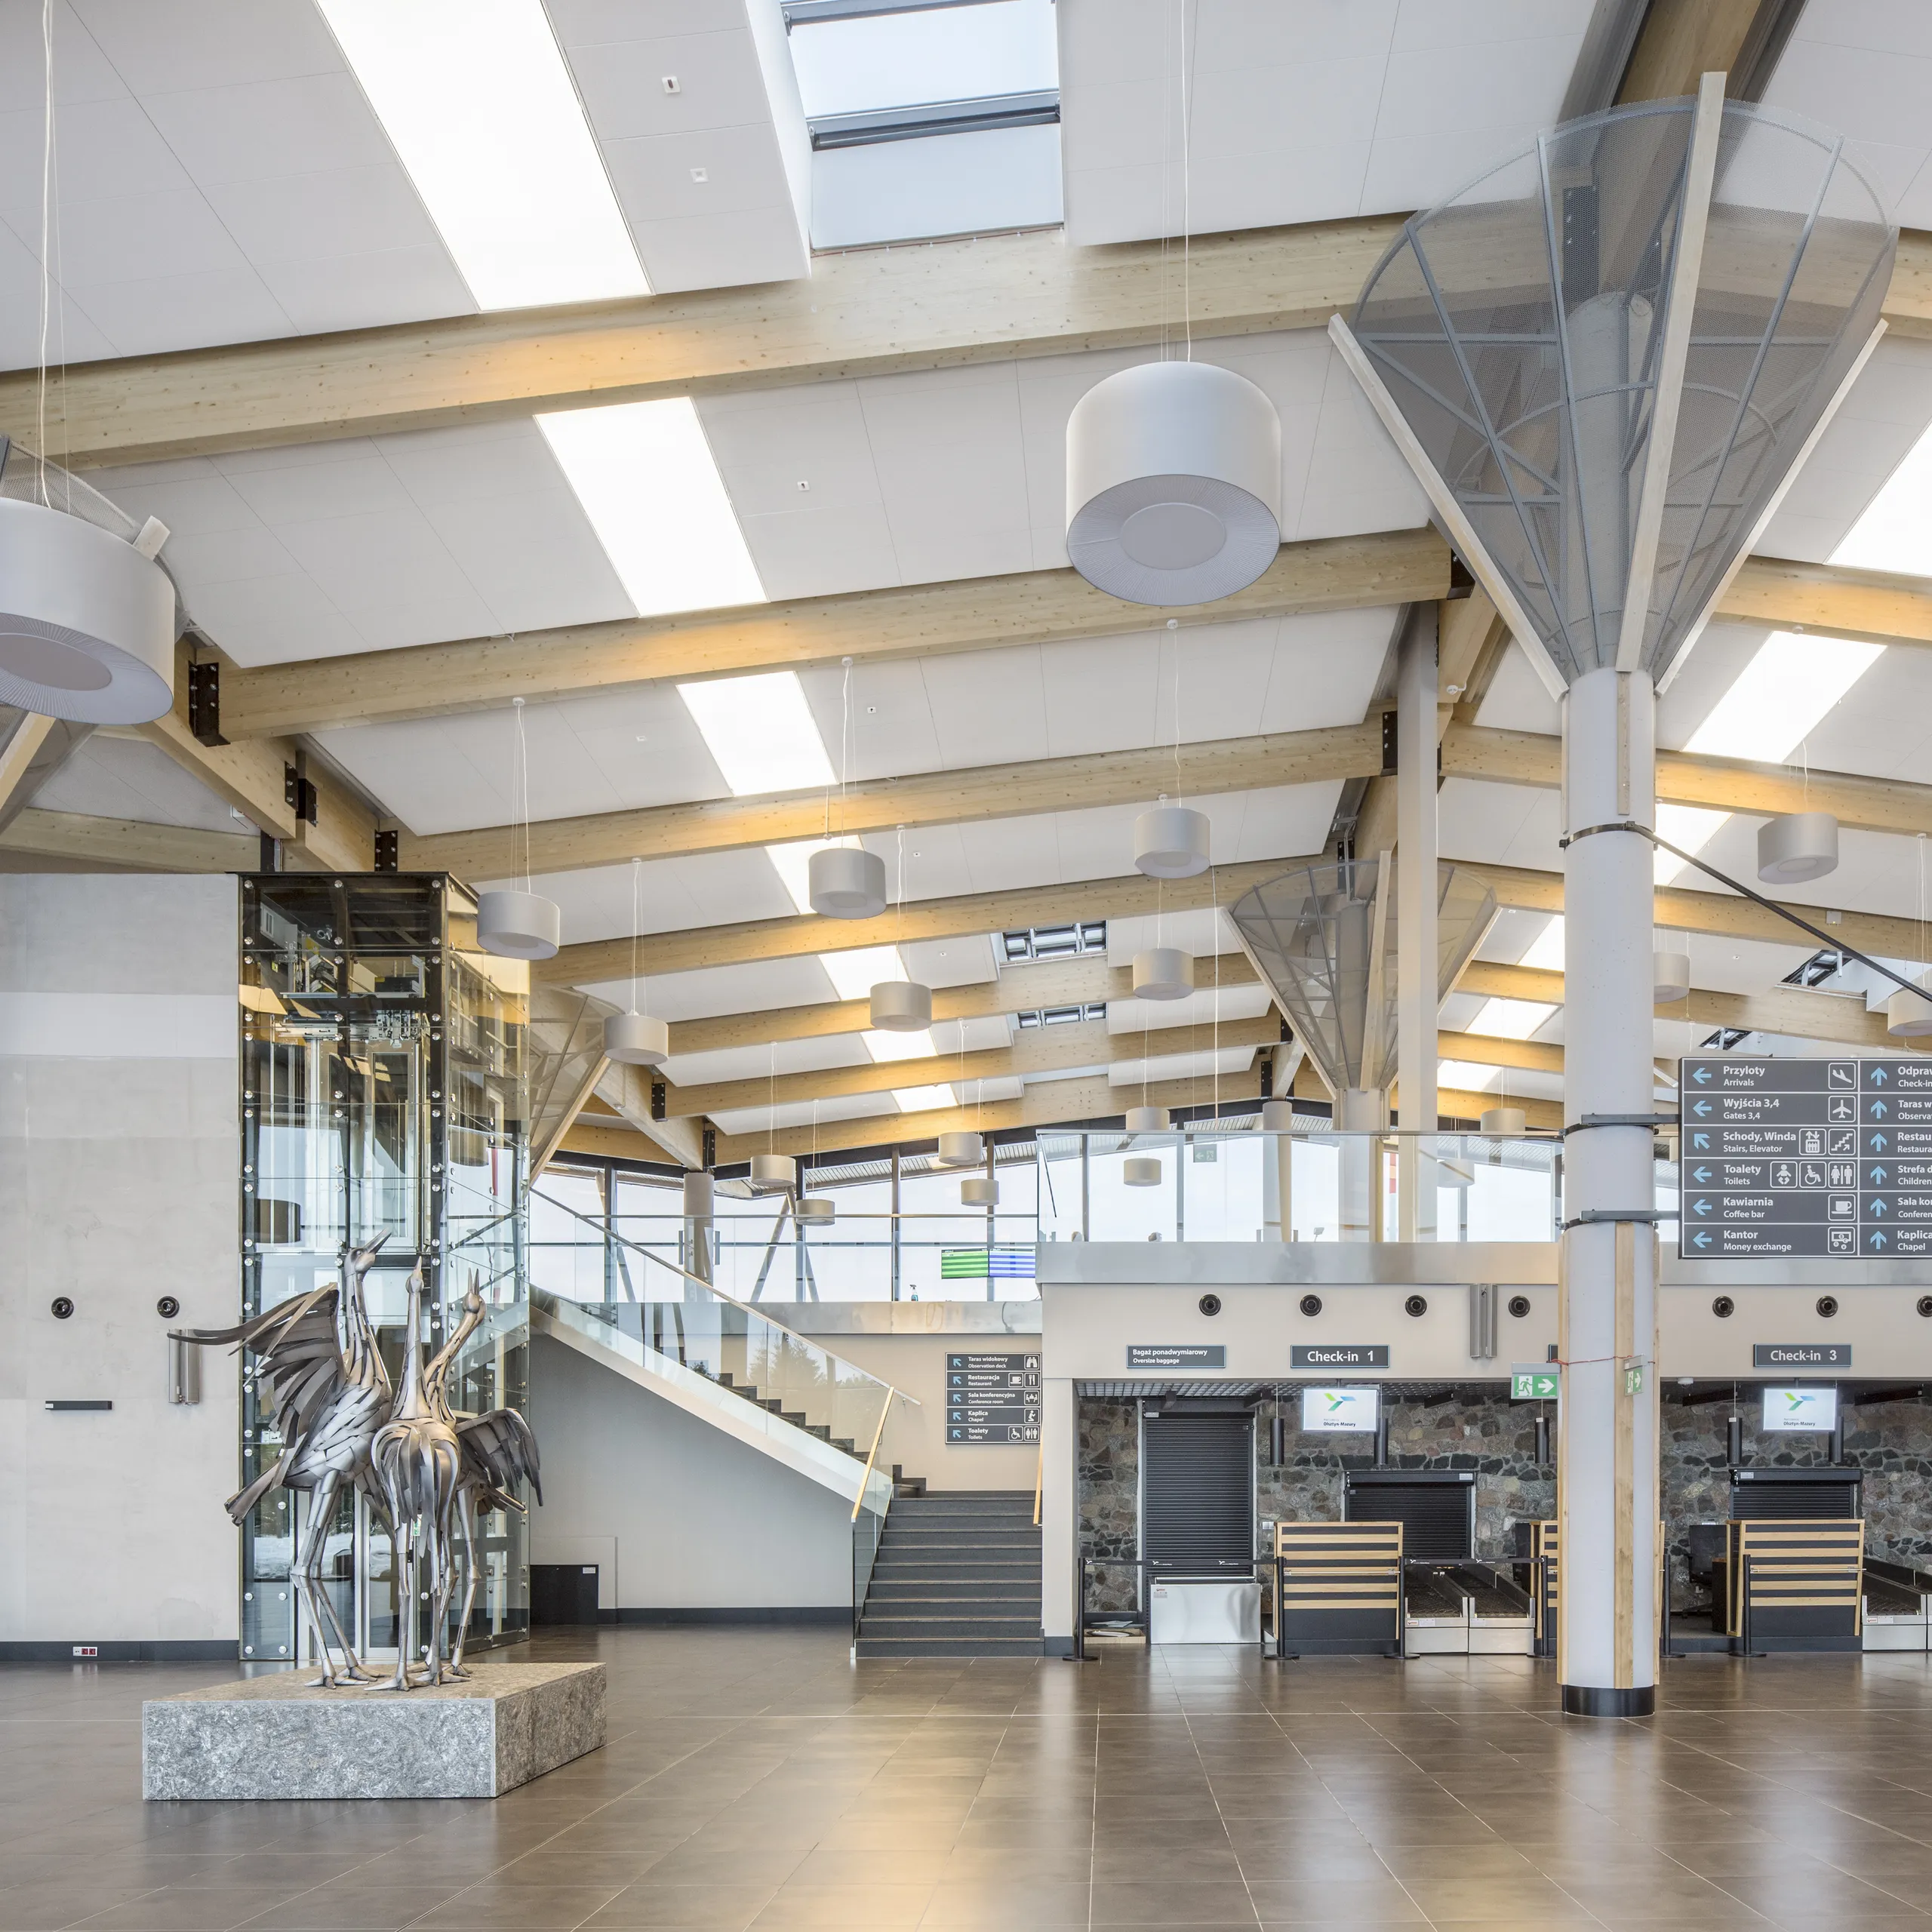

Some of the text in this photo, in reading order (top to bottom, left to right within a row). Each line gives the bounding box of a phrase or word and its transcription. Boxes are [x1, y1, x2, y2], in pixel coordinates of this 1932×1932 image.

[1723, 1065, 1766, 1077] Przyloty
[1723, 1078, 1755, 1087] Arrivals
[1723, 1098, 1780, 1109] Wyjścia 3,4
[1897, 1100, 1923, 1108] Taras
[1897, 1112, 1932, 1120] Observa
[1723, 1131, 1797, 1143] Schody, Winda
[1897, 1131, 1932, 1141] Restau
[1723, 1144, 1783, 1154] Stairs, Elevator
[1724, 1164, 1761, 1176] Toalety
[1897, 1164, 1925, 1174] Strefa
[1723, 1177, 1751, 1185] Toilets
[1897, 1177, 1932, 1185] Children
[1723, 1197, 1774, 1206] Kawiarnia
[1897, 1197, 1917, 1206] Sala
[1723, 1210, 1765, 1218] Coffee bar
[1724, 1230, 1758, 1239] Kantor
[1724, 1242, 1792, 1252] Money exchange
[1897, 1242, 1926, 1252] Chapel
[1132, 1349, 1208, 1357] Bagaż ponadwymiarowy
[1307, 1350, 1374, 1362] Check-in 1
[1770, 1349, 1837, 1361] Check-in 3
